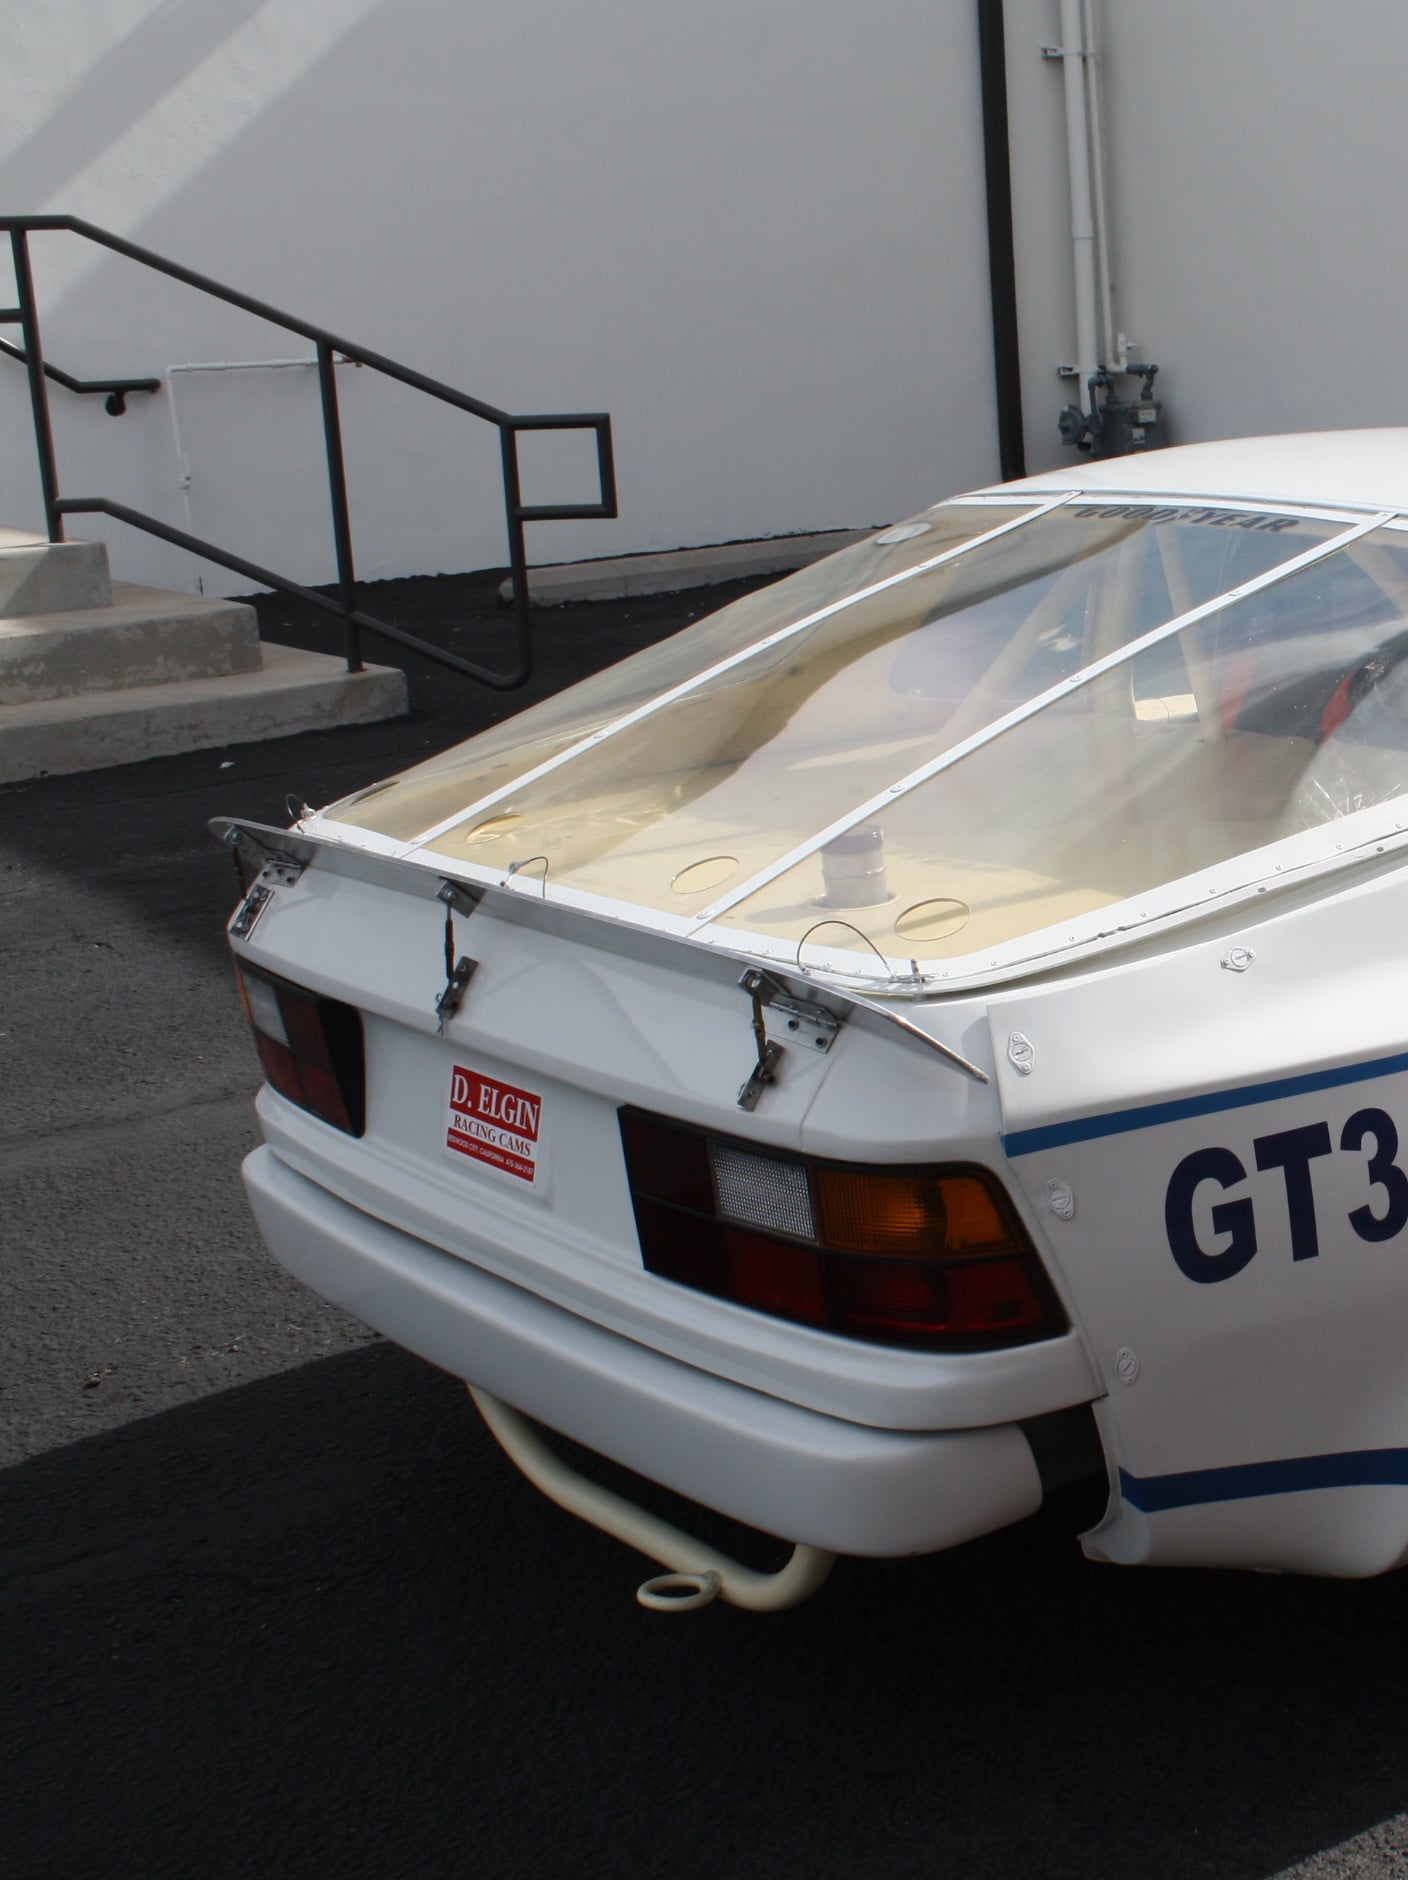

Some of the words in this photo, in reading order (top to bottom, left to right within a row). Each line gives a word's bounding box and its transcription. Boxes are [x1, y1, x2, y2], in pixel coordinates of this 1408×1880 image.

[1074, 506, 1300, 532] GOODYEAR
[452, 1074, 472, 1108] D.
[478, 1083, 539, 1134] ELGIN
[454, 1114, 496, 1142] RACING
[499, 1133, 531, 1157] CAMS
